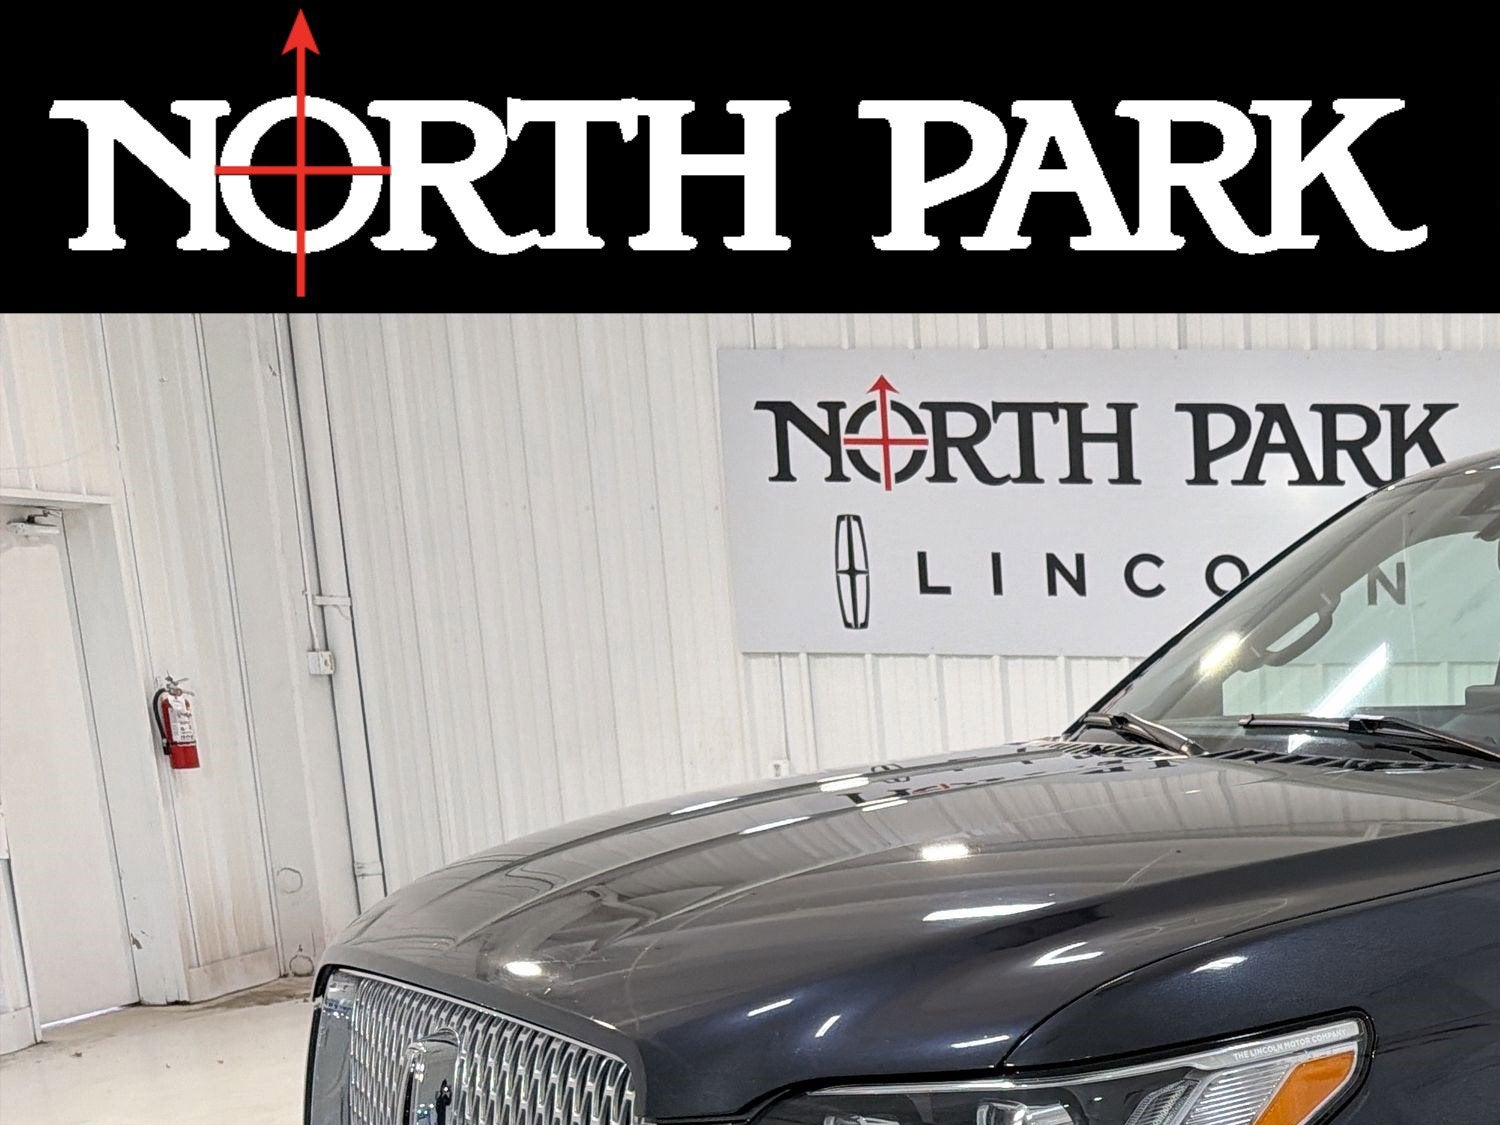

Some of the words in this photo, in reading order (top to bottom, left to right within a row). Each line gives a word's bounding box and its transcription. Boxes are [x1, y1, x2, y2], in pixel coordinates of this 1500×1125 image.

[753, 399, 1142, 487] NORTH
[1174, 401, 1461, 487] PARK
[1233, 1050, 1249, 1061] THE
[1250, 1043, 1283, 1057] LINCOLN
[1284, 1036, 1311, 1050] MOTOR
[1312, 1028, 1347, 1042] COMPANY
